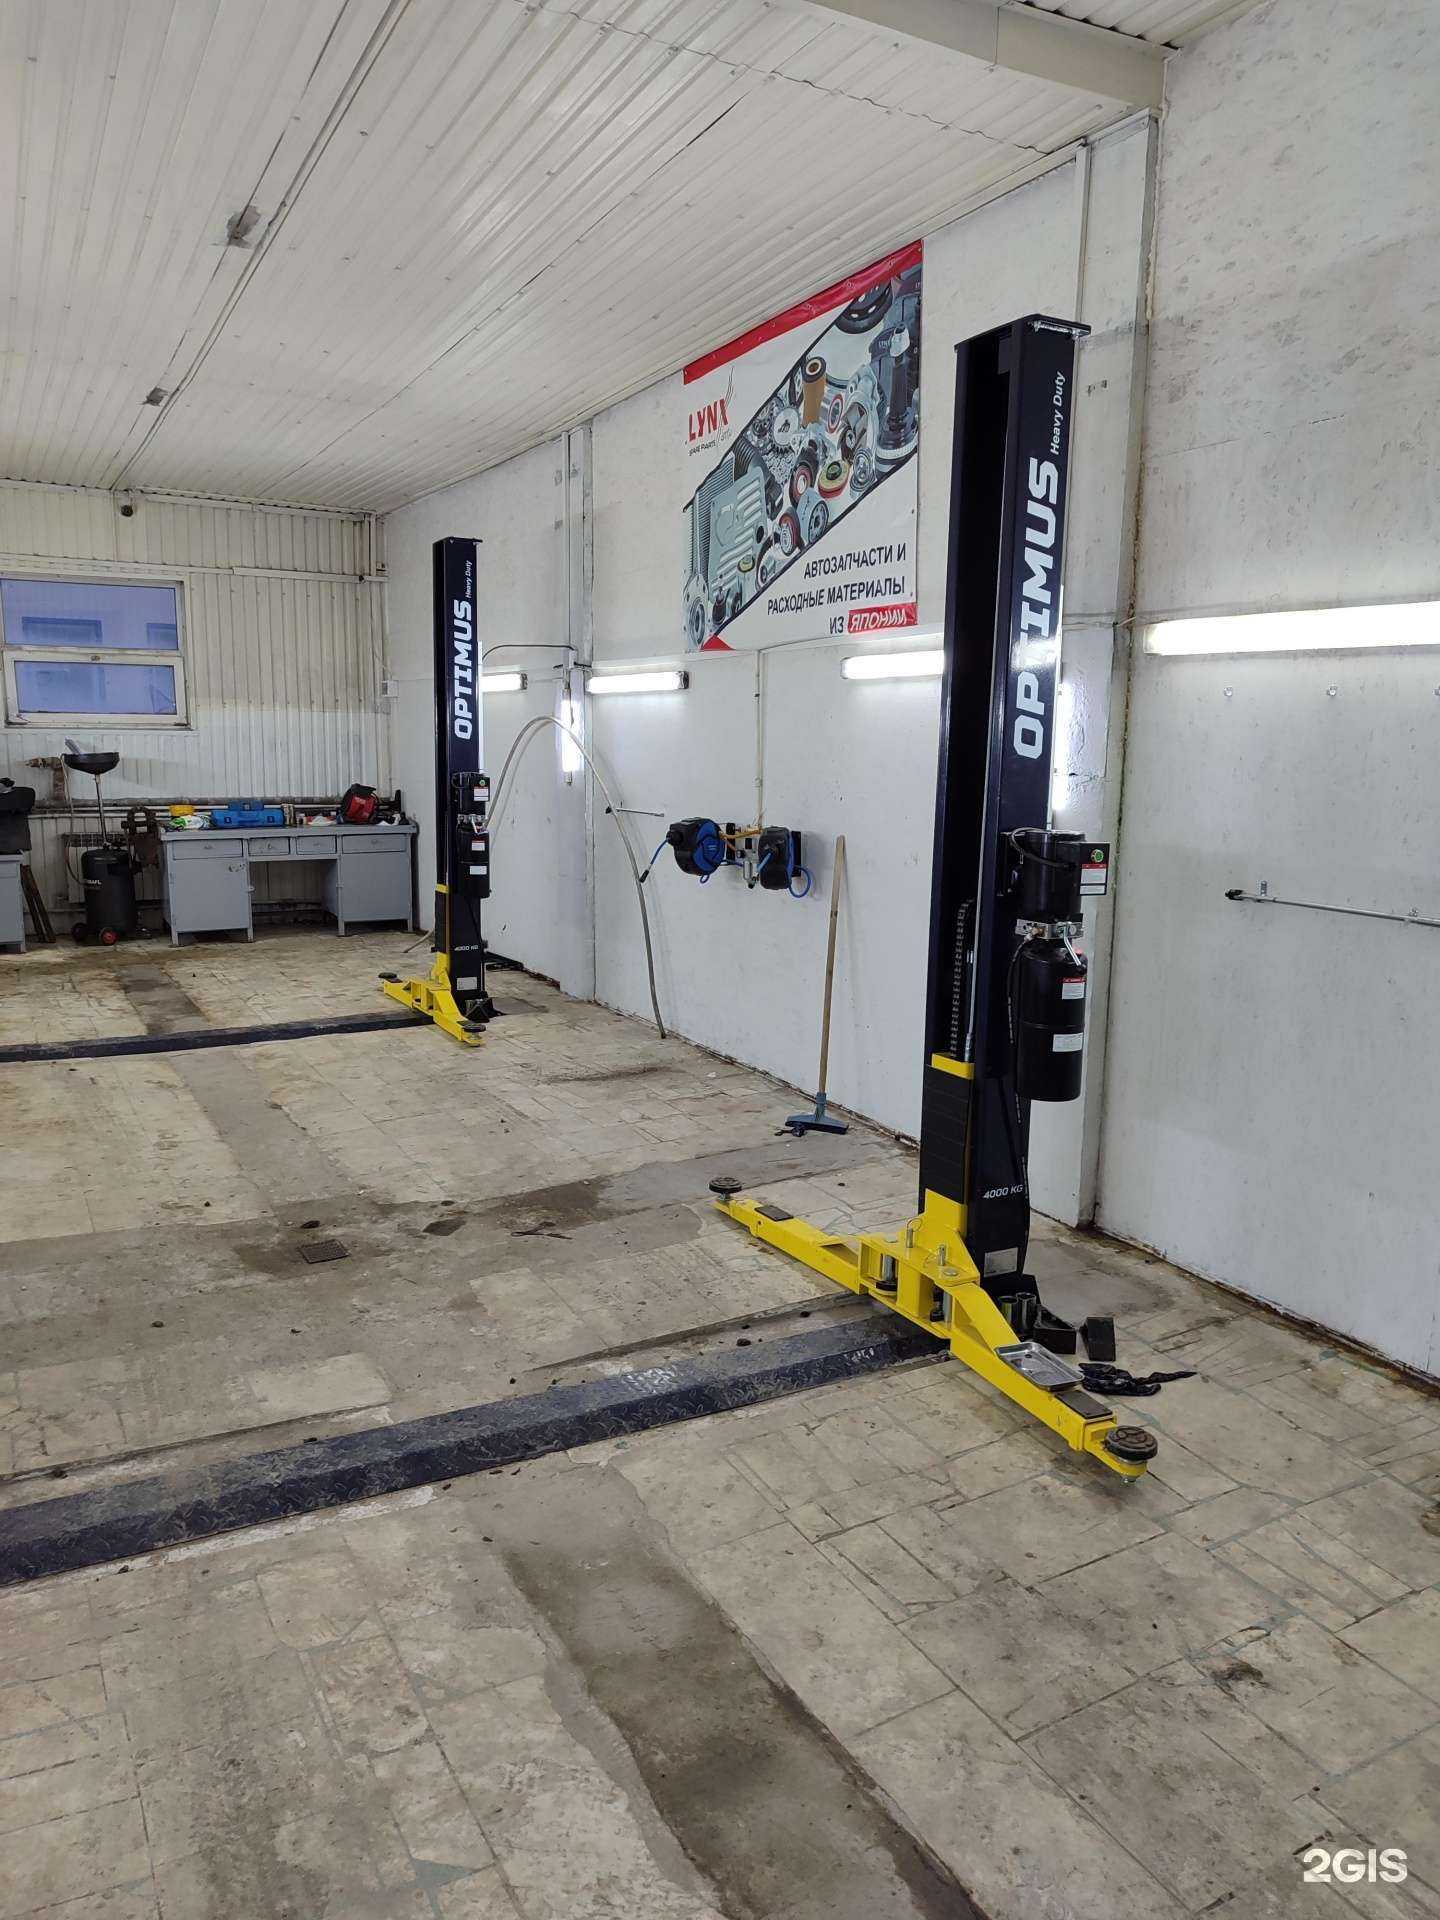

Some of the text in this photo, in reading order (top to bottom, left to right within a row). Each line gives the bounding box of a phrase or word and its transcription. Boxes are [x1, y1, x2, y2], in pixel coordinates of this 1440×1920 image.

[689, 399, 728, 442] LYNX
[1050, 370, 1066, 456] Heavy Duty
[804, 542, 906, 579] АВТОЗАПЧАСТИ И
[767, 576, 905, 615] РАСХОДНЫЕ МАТЕРИАЛЫ
[829, 608, 907, 634] ИЗ ЯПОНИИ
[454, 599, 473, 741] OPTIMUS
[983, 1184, 1024, 1199] 4000 KG
